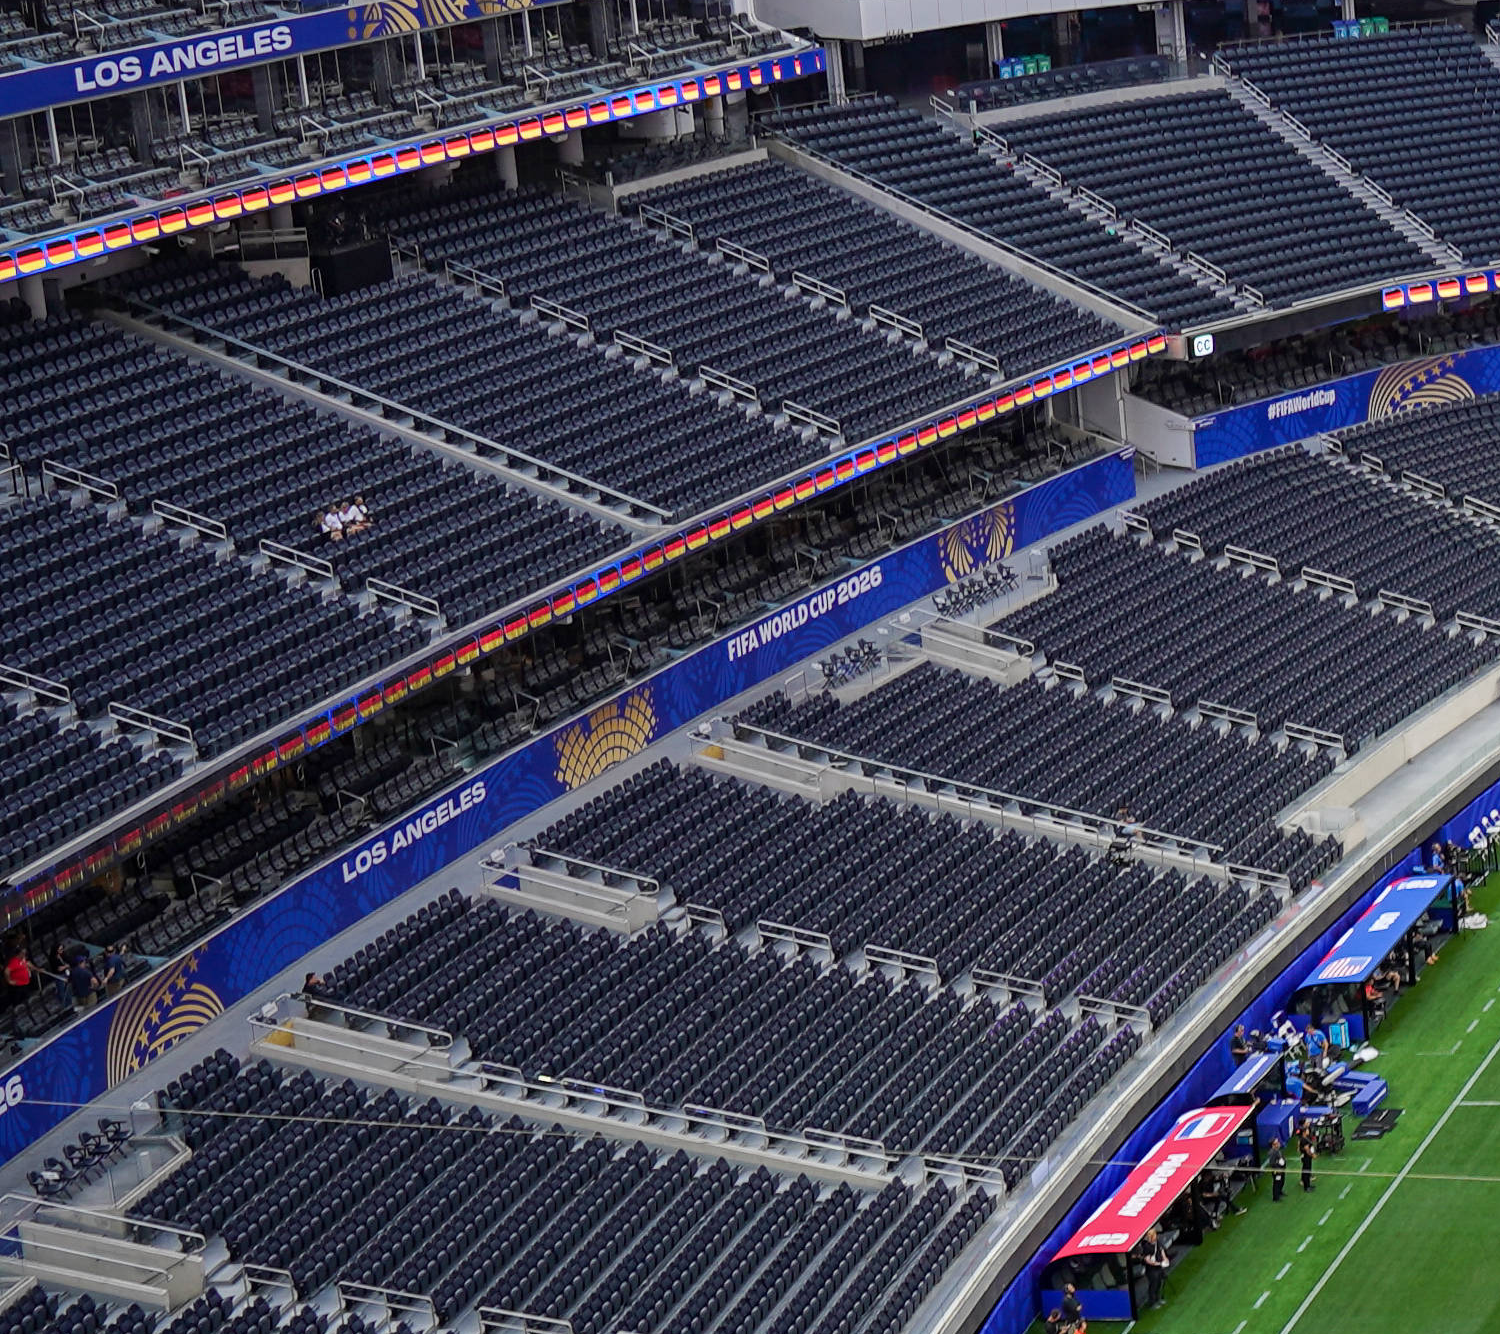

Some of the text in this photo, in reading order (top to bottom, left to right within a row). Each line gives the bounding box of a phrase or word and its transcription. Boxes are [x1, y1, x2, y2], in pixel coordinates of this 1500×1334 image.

[74, 24, 292, 94] LOS ANGELES
[1268, 390, 1335, 419] #FIFAWorldCup
[728, 566, 882, 661] FIFA WORLD CUP 2026
[342, 781, 487, 883] LOS ANGELES
